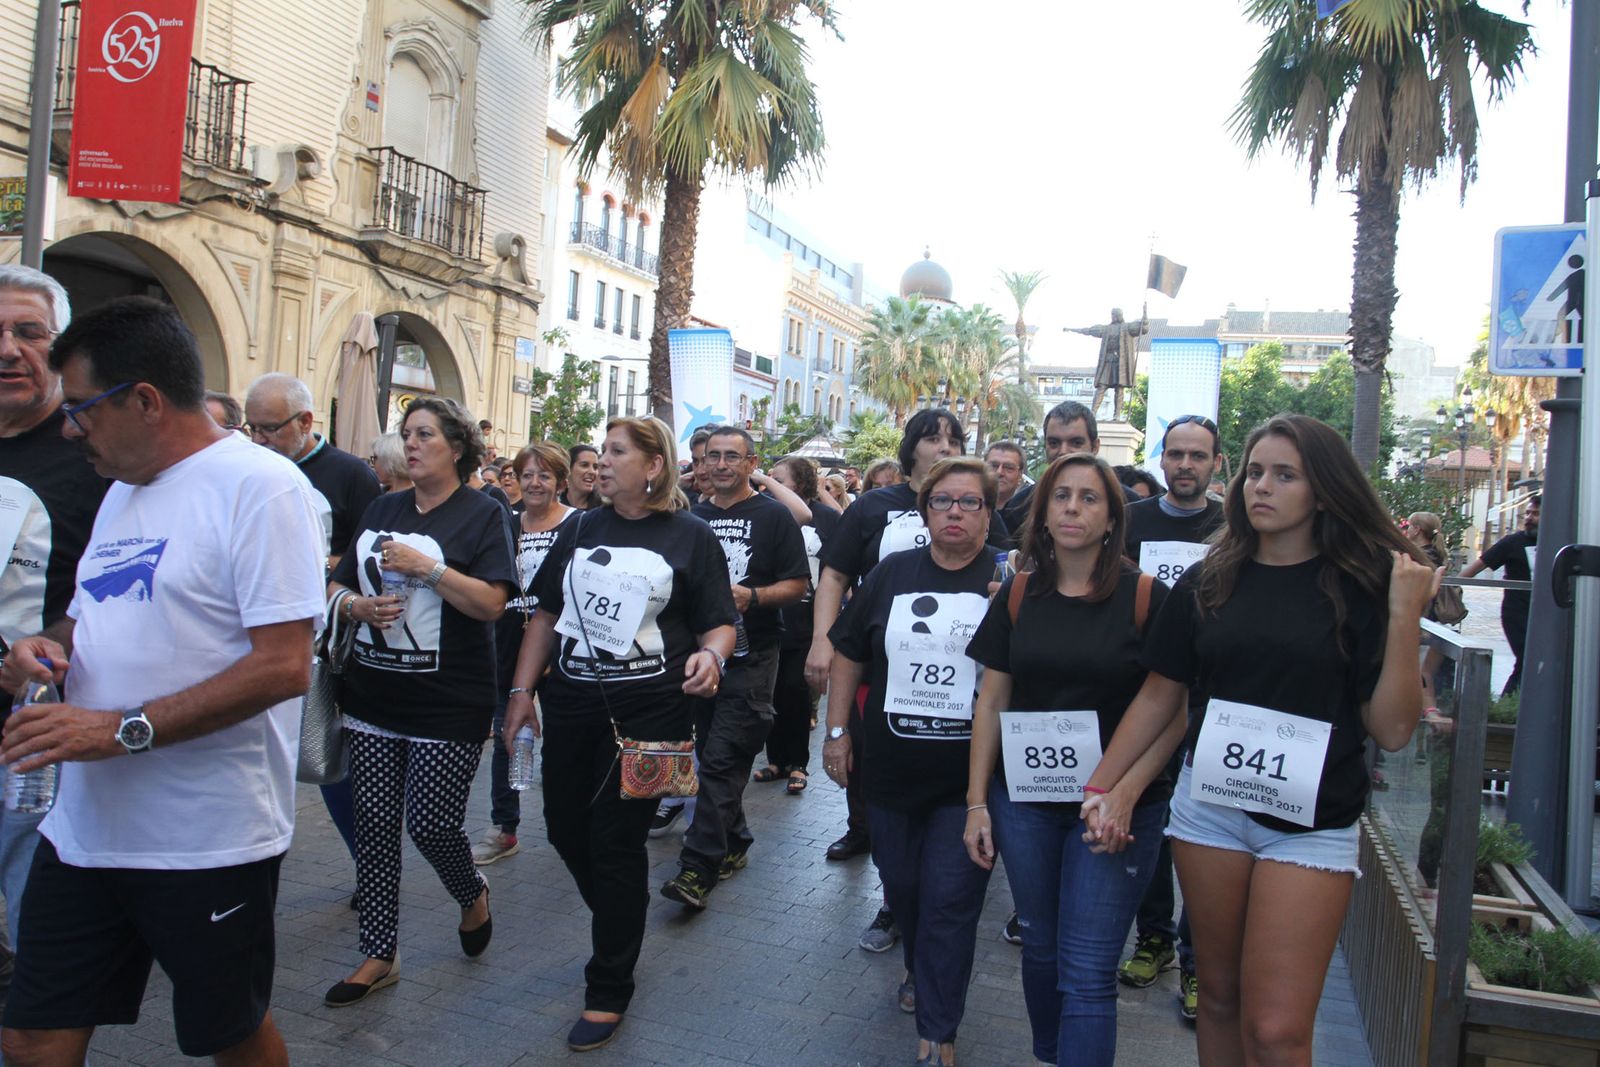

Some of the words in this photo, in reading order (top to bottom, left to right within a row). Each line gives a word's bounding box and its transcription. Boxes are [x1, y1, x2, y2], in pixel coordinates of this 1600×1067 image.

[159, 18, 184, 27] Huelva
[584, 590, 622, 622] 781
[580, 616, 612, 634] CIRCUITOS
[607, 636, 625, 648] 2017
[909, 662, 956, 687] 782
[912, 689, 950, 700] CIRCUITOS
[893, 697, 946, 710] PROVINCIALES
[947, 703, 964, 711] 2017
[1025, 746, 1078, 770] 838
[1222, 742, 1288, 782] 841
[1033, 775, 1077, 784] CIRCUITOS
[1225, 777, 1279, 797] CIRCUITOS
[1016, 785, 1075, 793] PROVINCIALES
[1201, 783, 1274, 806] PROVINCIALES
[1276, 800, 1303, 814] 2017
